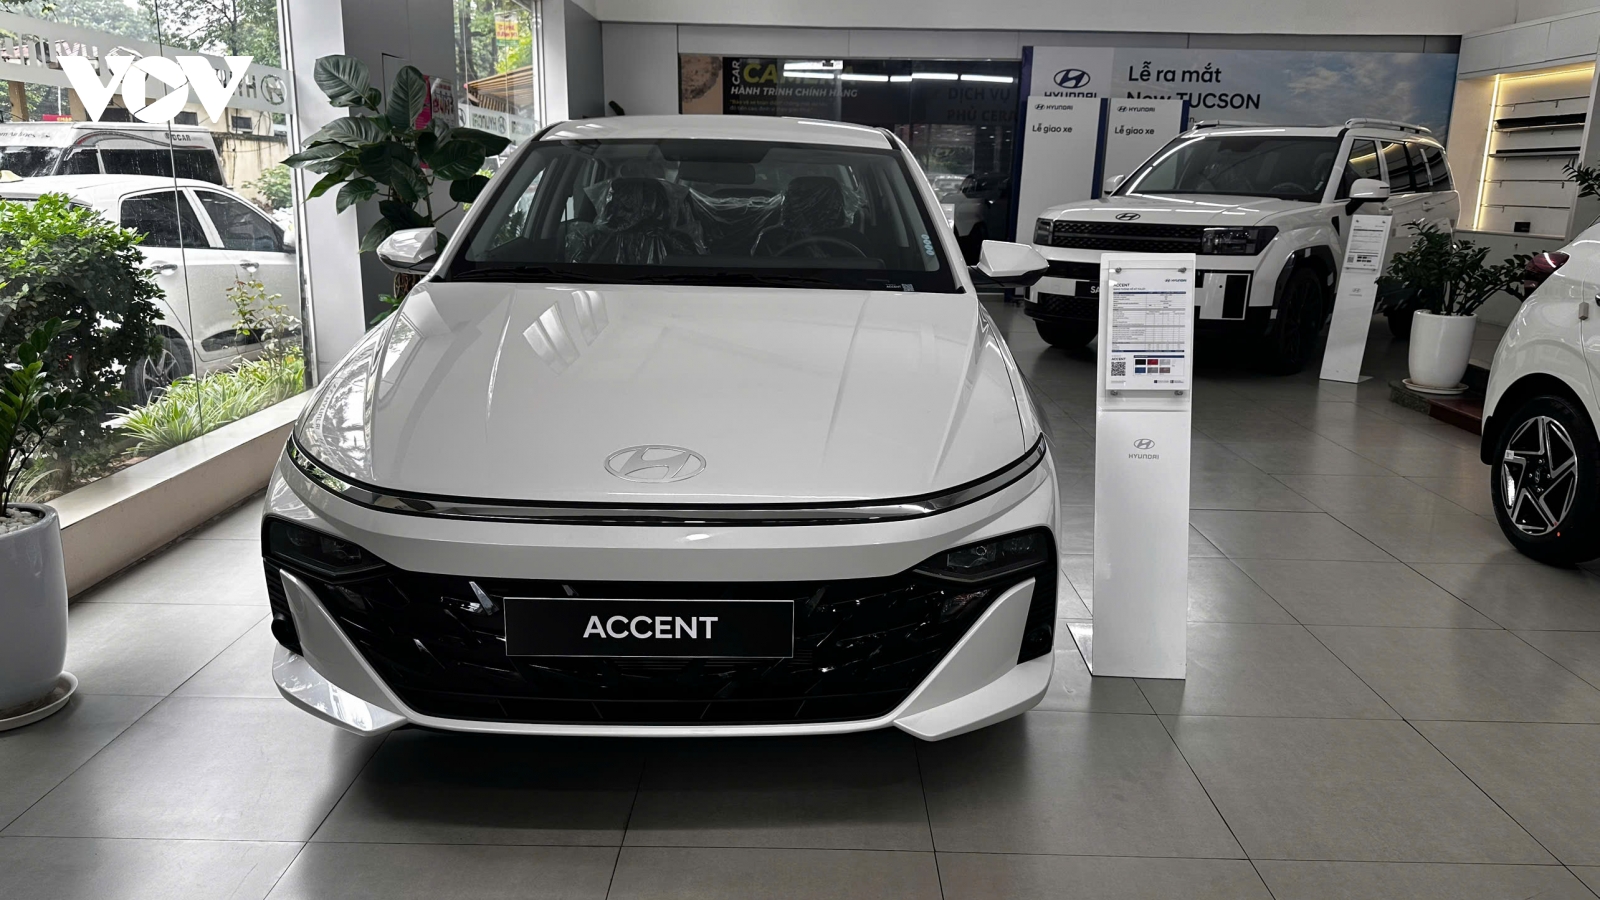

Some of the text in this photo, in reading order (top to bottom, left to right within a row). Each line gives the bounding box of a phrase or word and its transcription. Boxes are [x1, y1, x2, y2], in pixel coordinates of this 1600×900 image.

[731, 60, 741, 85] CAR
[1128, 61, 1222, 83] Lễ ra mắt
[730, 84, 760, 96] HÀNH
[795, 86, 827, 98] CHÍNH
[948, 87, 985, 104] DỊCH
[1176, 93, 1260, 109] TUCSON
[1032, 123, 1042, 133] Lễ
[1043, 125, 1062, 134] giao
[1114, 124, 1125, 134] Lễ
[1126, 127, 1144, 136] giao
[583, 615, 719, 639] ACCENT
